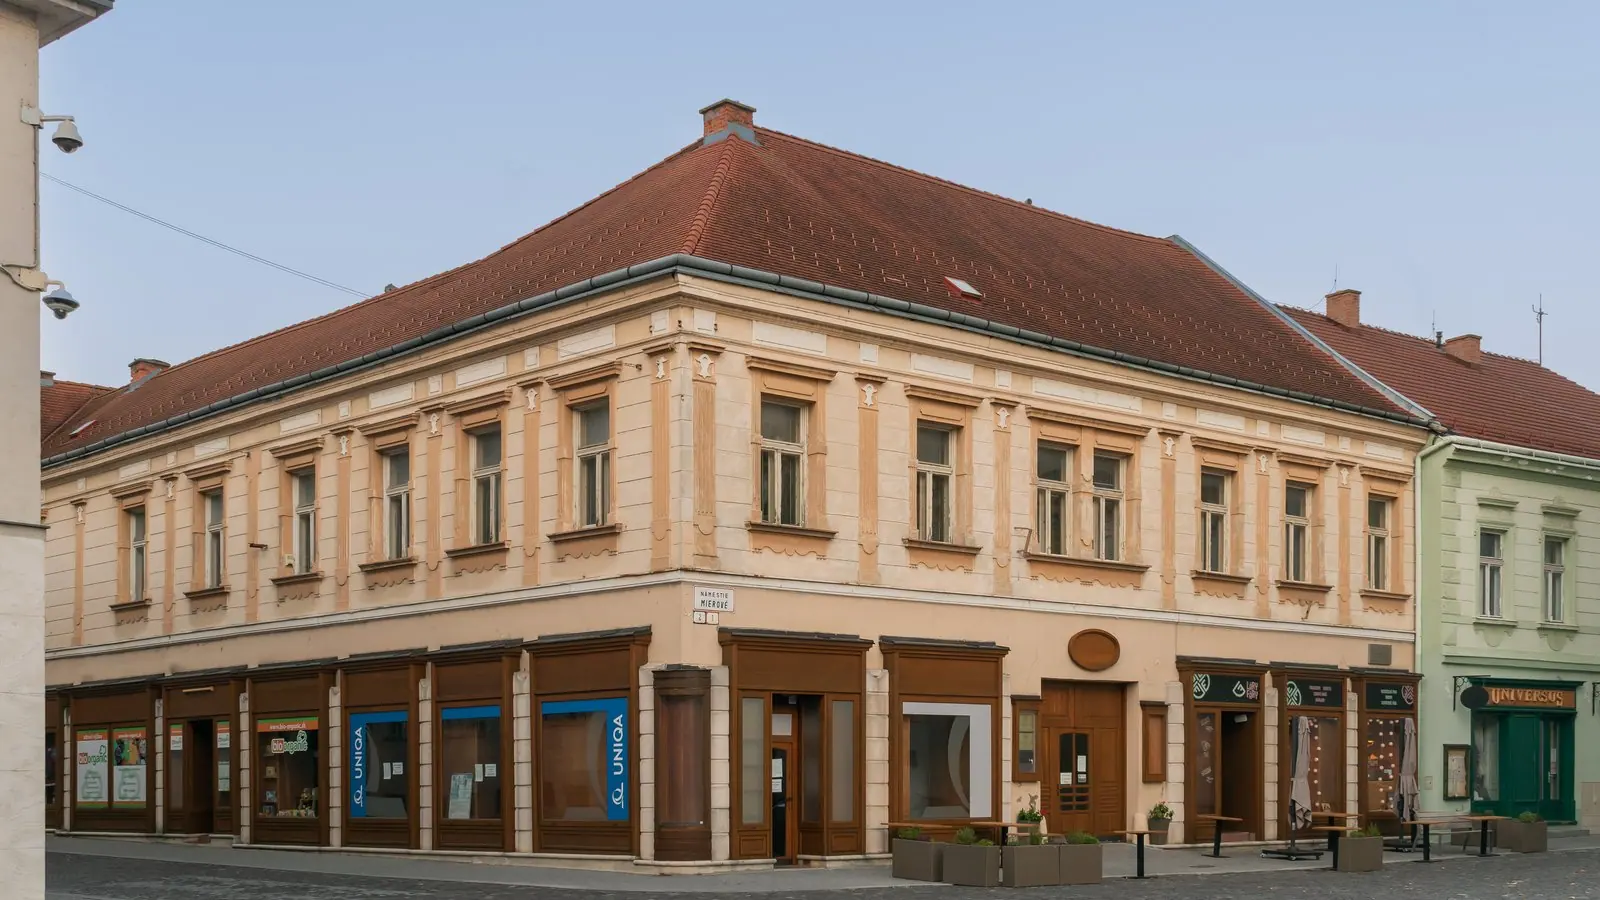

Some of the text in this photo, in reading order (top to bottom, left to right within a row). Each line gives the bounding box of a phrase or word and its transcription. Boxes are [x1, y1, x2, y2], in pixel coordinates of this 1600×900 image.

[1491, 688, 1564, 706] UNIVERSUS
[354, 727, 363, 779] UNIQA
[613, 714, 624, 776] UNIQA
